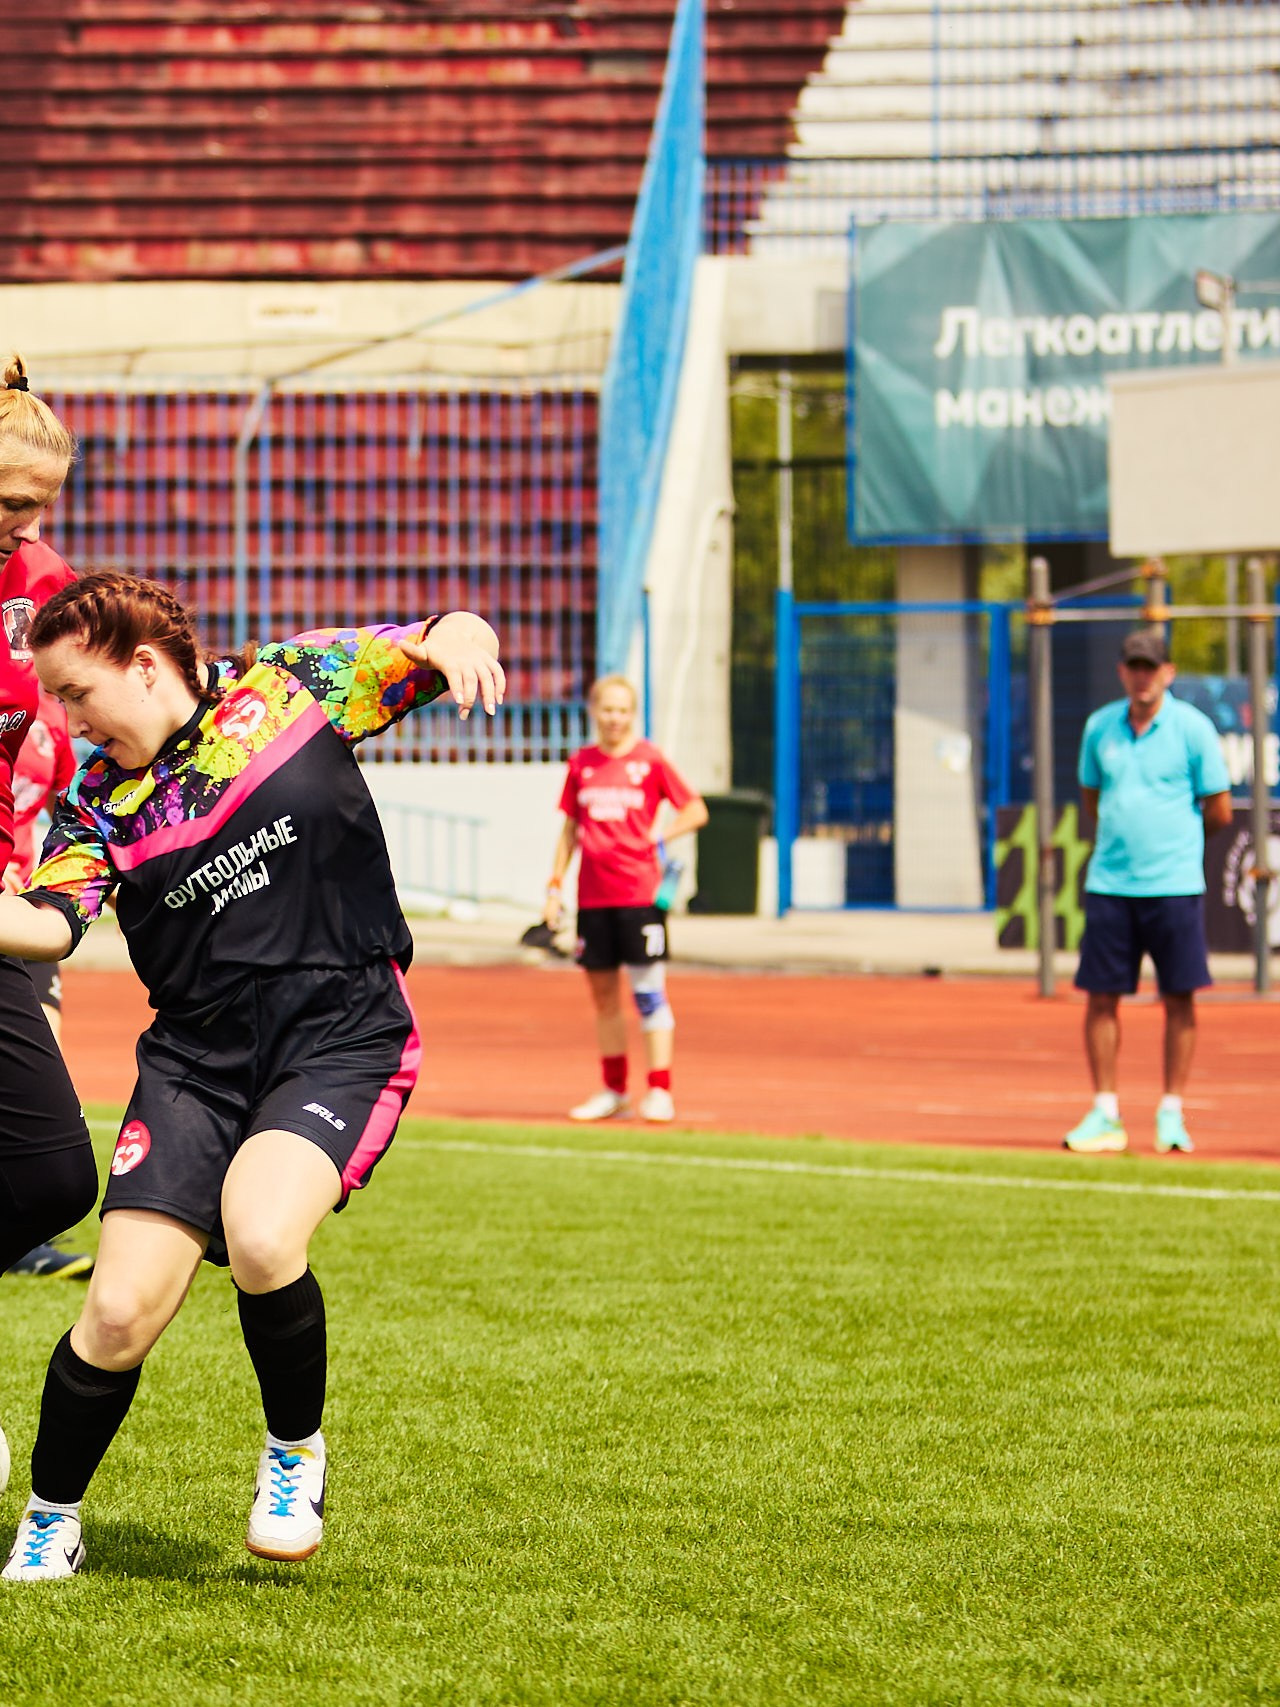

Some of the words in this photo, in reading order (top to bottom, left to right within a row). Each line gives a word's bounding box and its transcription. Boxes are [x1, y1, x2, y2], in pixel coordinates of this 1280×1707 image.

[935, 385, 1113, 429] манеж
[221, 700, 267, 740] 52
[164, 814, 298, 909] ФУТБОЛЬНЫЕ
[111, 1143, 144, 1176] 52
